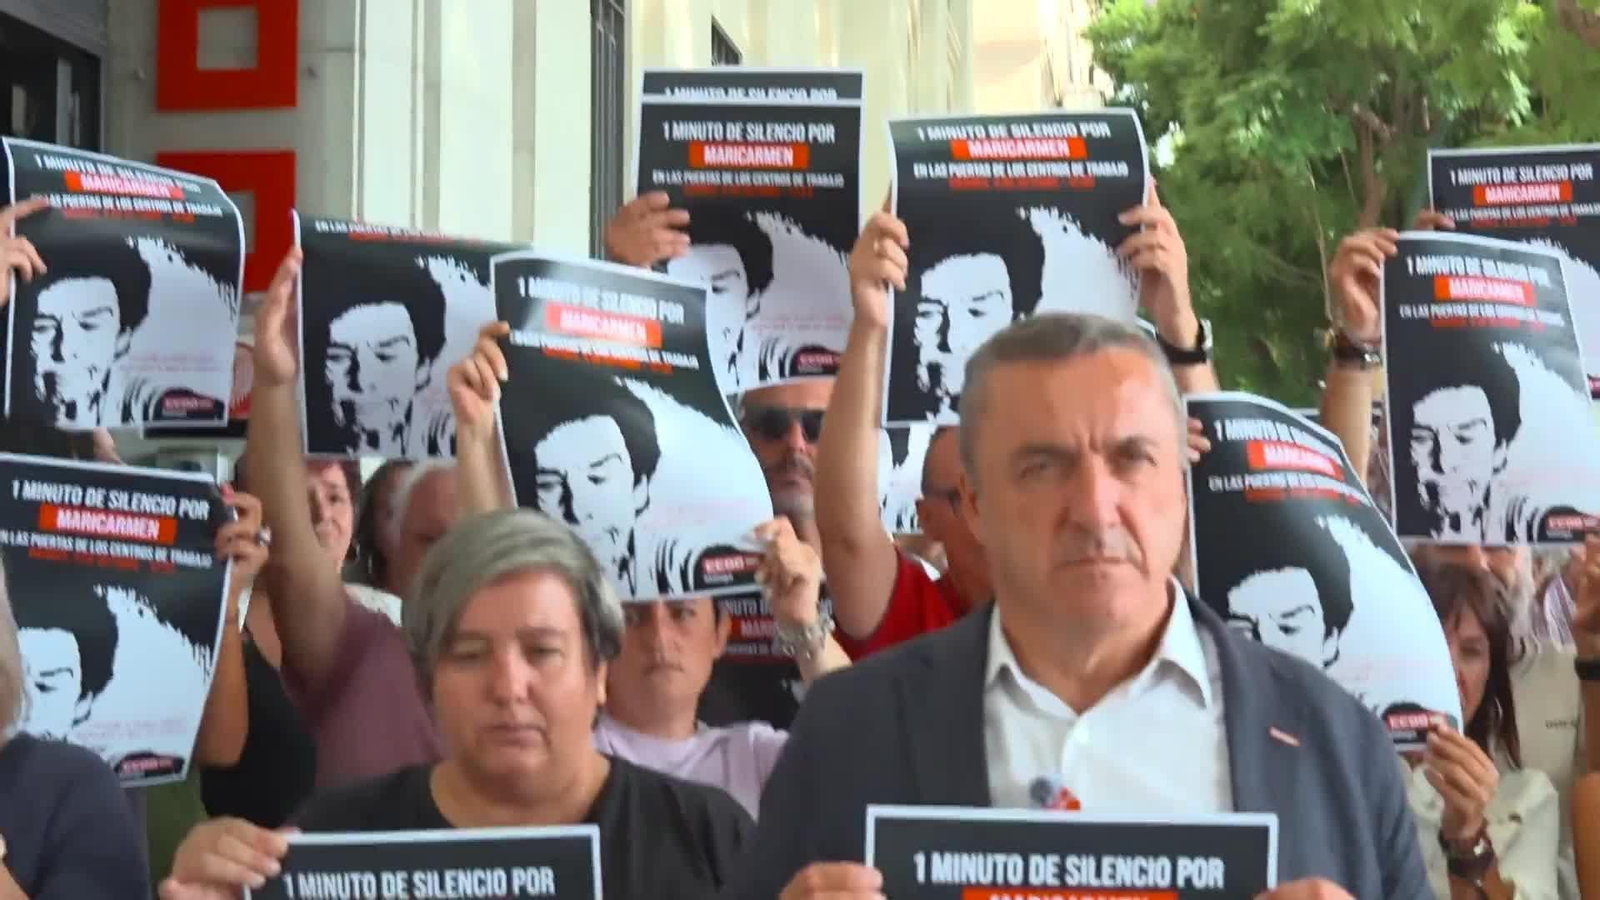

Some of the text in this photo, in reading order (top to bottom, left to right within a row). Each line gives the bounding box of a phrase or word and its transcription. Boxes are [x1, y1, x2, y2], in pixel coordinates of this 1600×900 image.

[663, 120, 836, 144] 1 MINUTO DE SILENCIO POR
[926, 126, 986, 142] MINUTO
[987, 125, 1010, 140] DE
[1010, 122, 1079, 140] SILENCIO
[1078, 121, 1112, 139] POR
[704, 144, 794, 167] MARICARMEN
[967, 138, 1071, 160] MARICARMEN
[652, 170, 665, 186] EN
[666, 170, 682, 186] LAS
[913, 162, 928, 180] EN
[929, 162, 948, 179] LAS
[1457, 167, 1502, 186] MINUTO
[1502, 166, 1518, 184] DE
[1519, 165, 1570, 184] SILENCIO
[1570, 163, 1593, 182] POR
[1485, 183, 1560, 204] MARICARMEN
[12, 478, 211, 521] 1 MINUTO DE SILENCIO POR
[56, 508, 160, 541] MARICARMEN
[10, 531, 29, 548] LAS
[284, 865, 556, 900] 1 MINUTO DE SILENCIO POR
[914, 852, 1225, 890] 1 MINUTO DE SILENCIO POR
